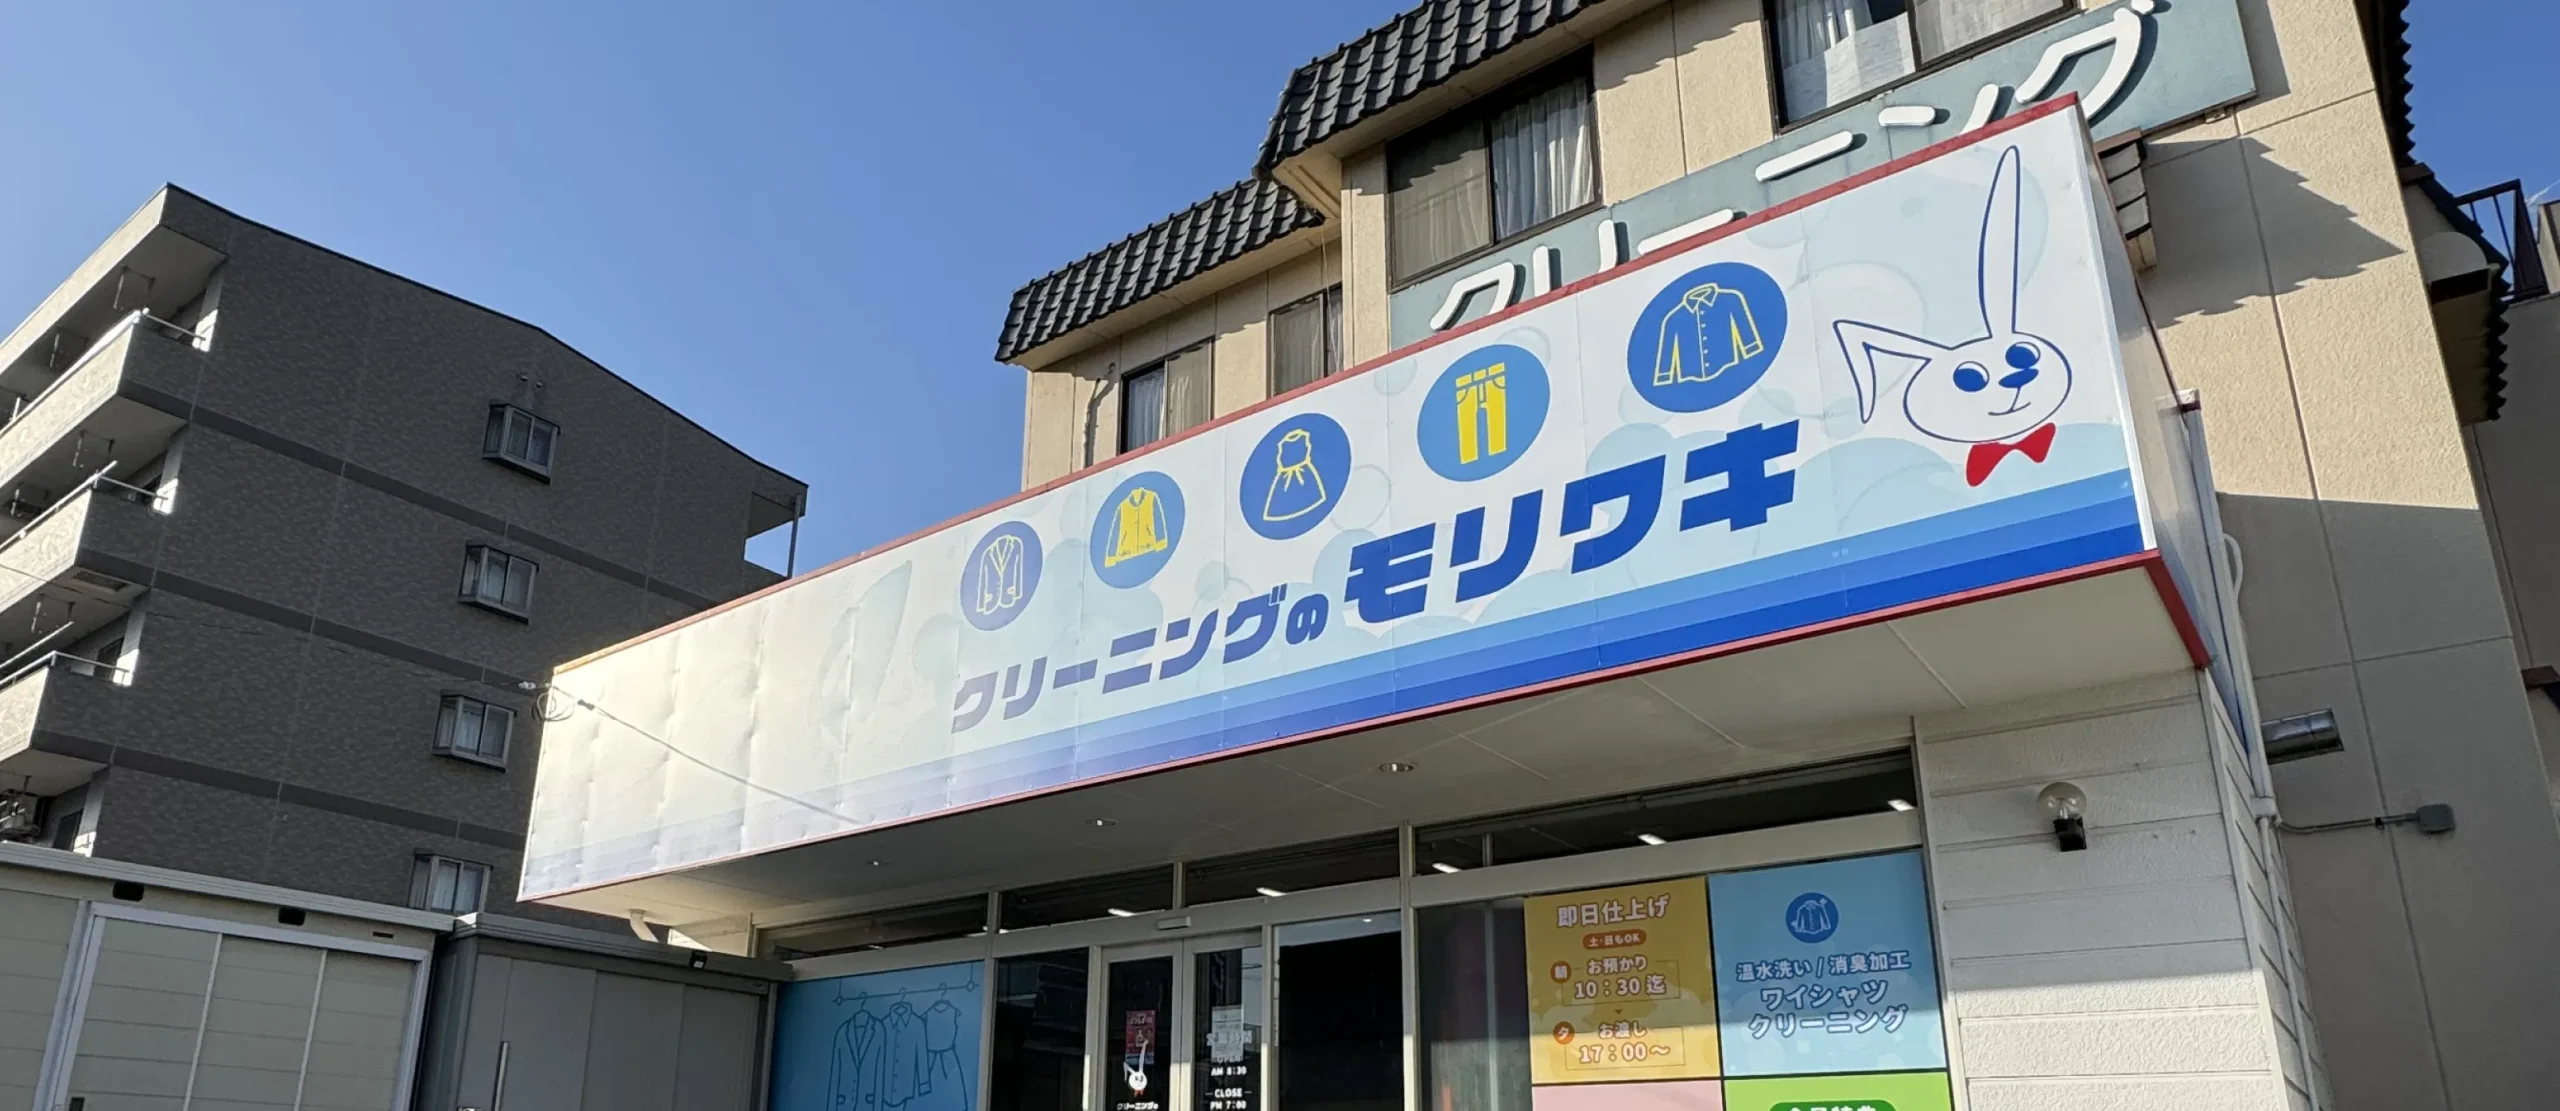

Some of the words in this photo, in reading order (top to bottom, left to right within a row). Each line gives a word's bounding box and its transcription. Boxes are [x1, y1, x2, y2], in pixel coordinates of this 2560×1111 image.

[1557, 893, 1671, 928] 即日仕上げ
[1588, 955, 1648, 976] お預かり
[1736, 959, 1812, 982] 温水洗い
[1828, 951, 1911, 975] 消臭加工
[1760, 979, 1888, 1011] ワイシャツ
[1598, 1020, 1648, 1039] お渡し
[1748, 1003, 1909, 1040] クリーニング
[1211, 1067, 1224, 1076] AM
[1214, 1088, 1243, 1098] CLOSE
[1210, 1101, 1223, 1110] PM
[1225, 1100, 1247, 1109] 7:00
